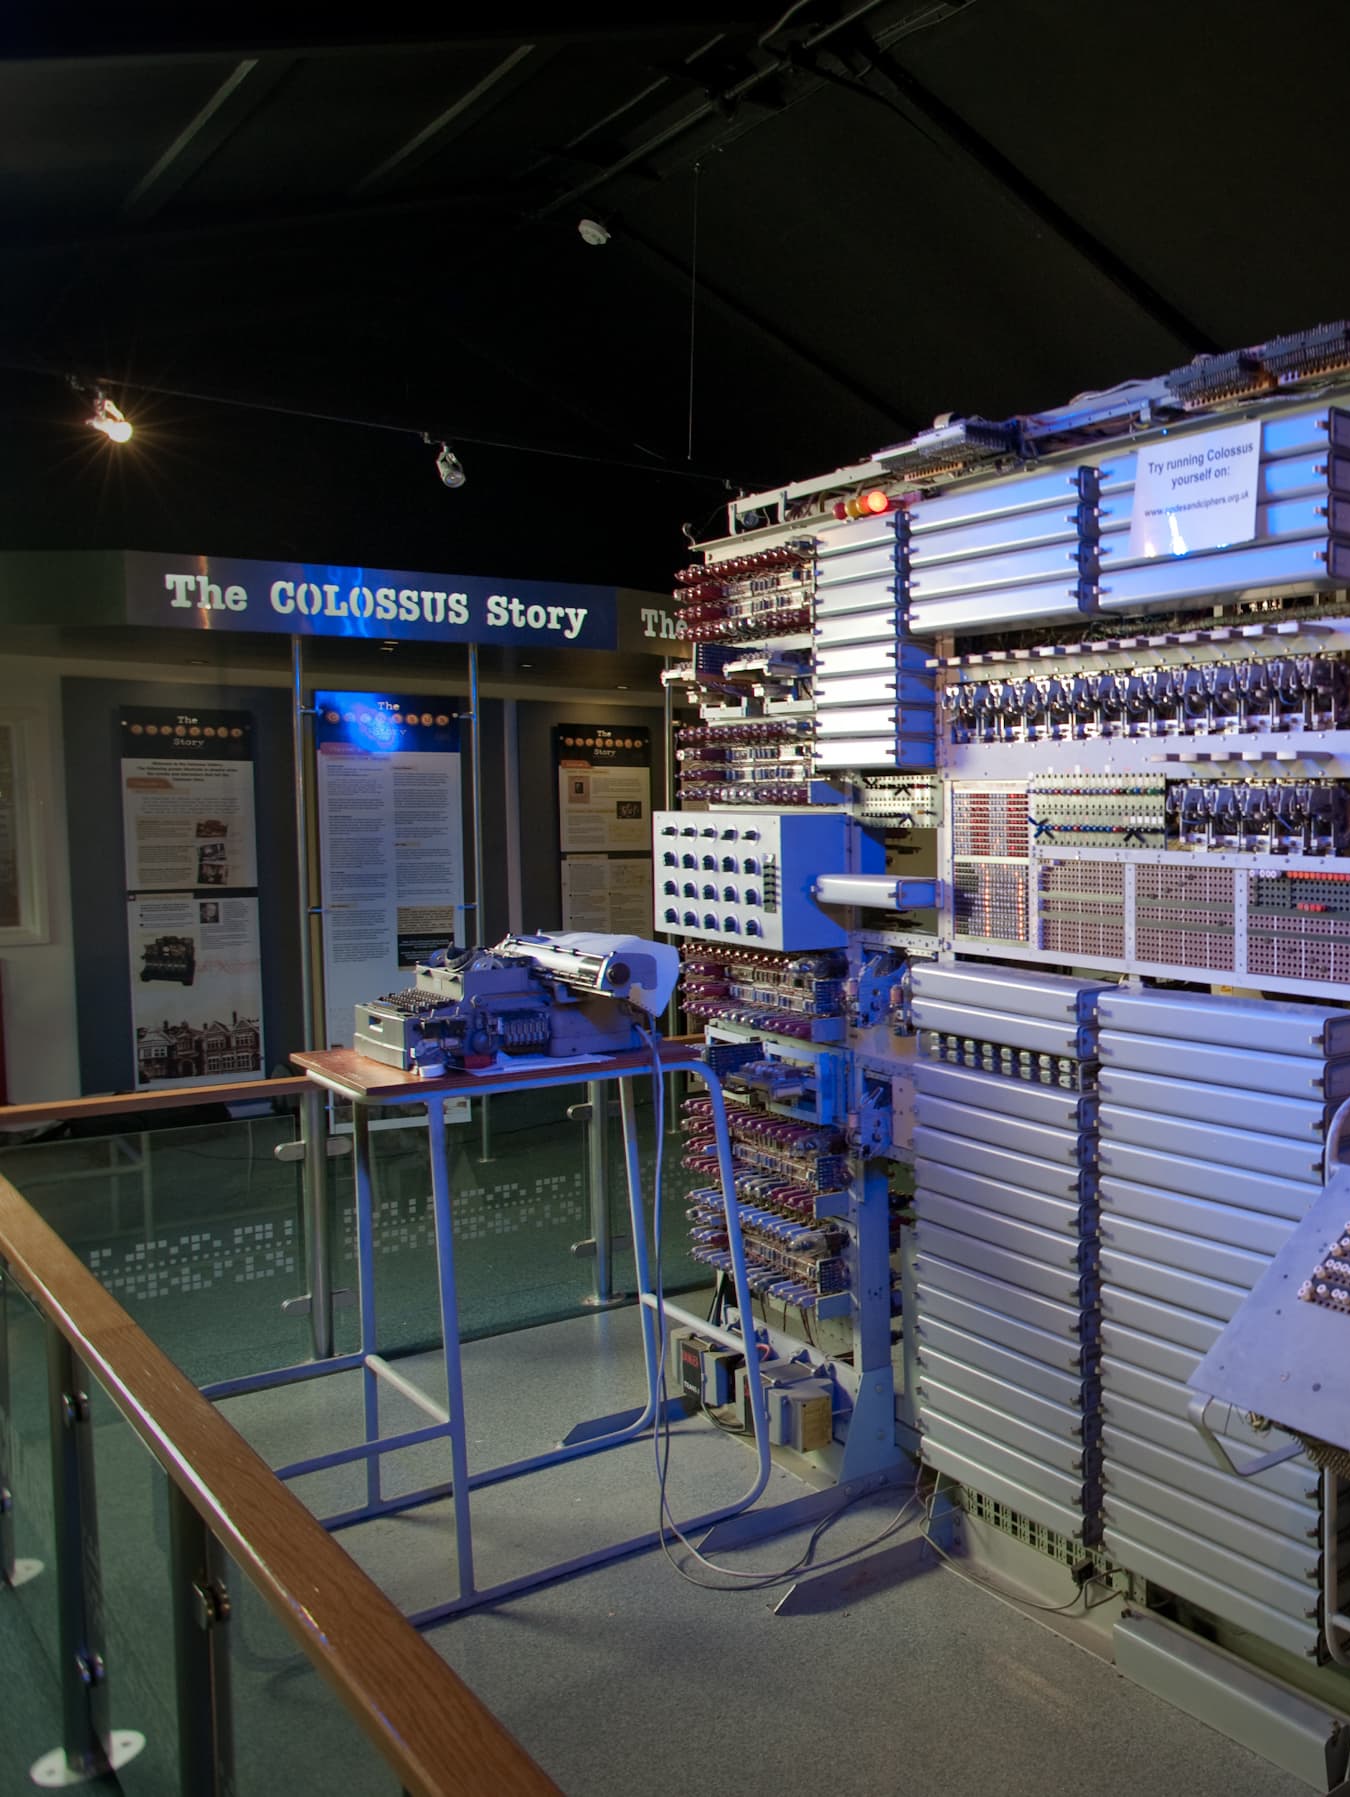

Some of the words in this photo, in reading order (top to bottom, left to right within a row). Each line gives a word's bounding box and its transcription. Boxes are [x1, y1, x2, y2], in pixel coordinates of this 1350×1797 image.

[1148, 462, 1164, 475] Try
[1166, 454, 1204, 470] running
[1207, 443, 1254, 461] Colossus
[1171, 467, 1212, 490] yourself
[1214, 465, 1230, 478] on:
[165, 574, 248, 611] The
[270, 580, 469, 624] COLOSSUS
[486, 595, 588, 639] Story
[641, 608, 688, 640] The
[377, 701, 400, 711] The
[176, 715, 198, 725] The
[173, 738, 205, 747] Story
[593, 748, 616, 757] Story
